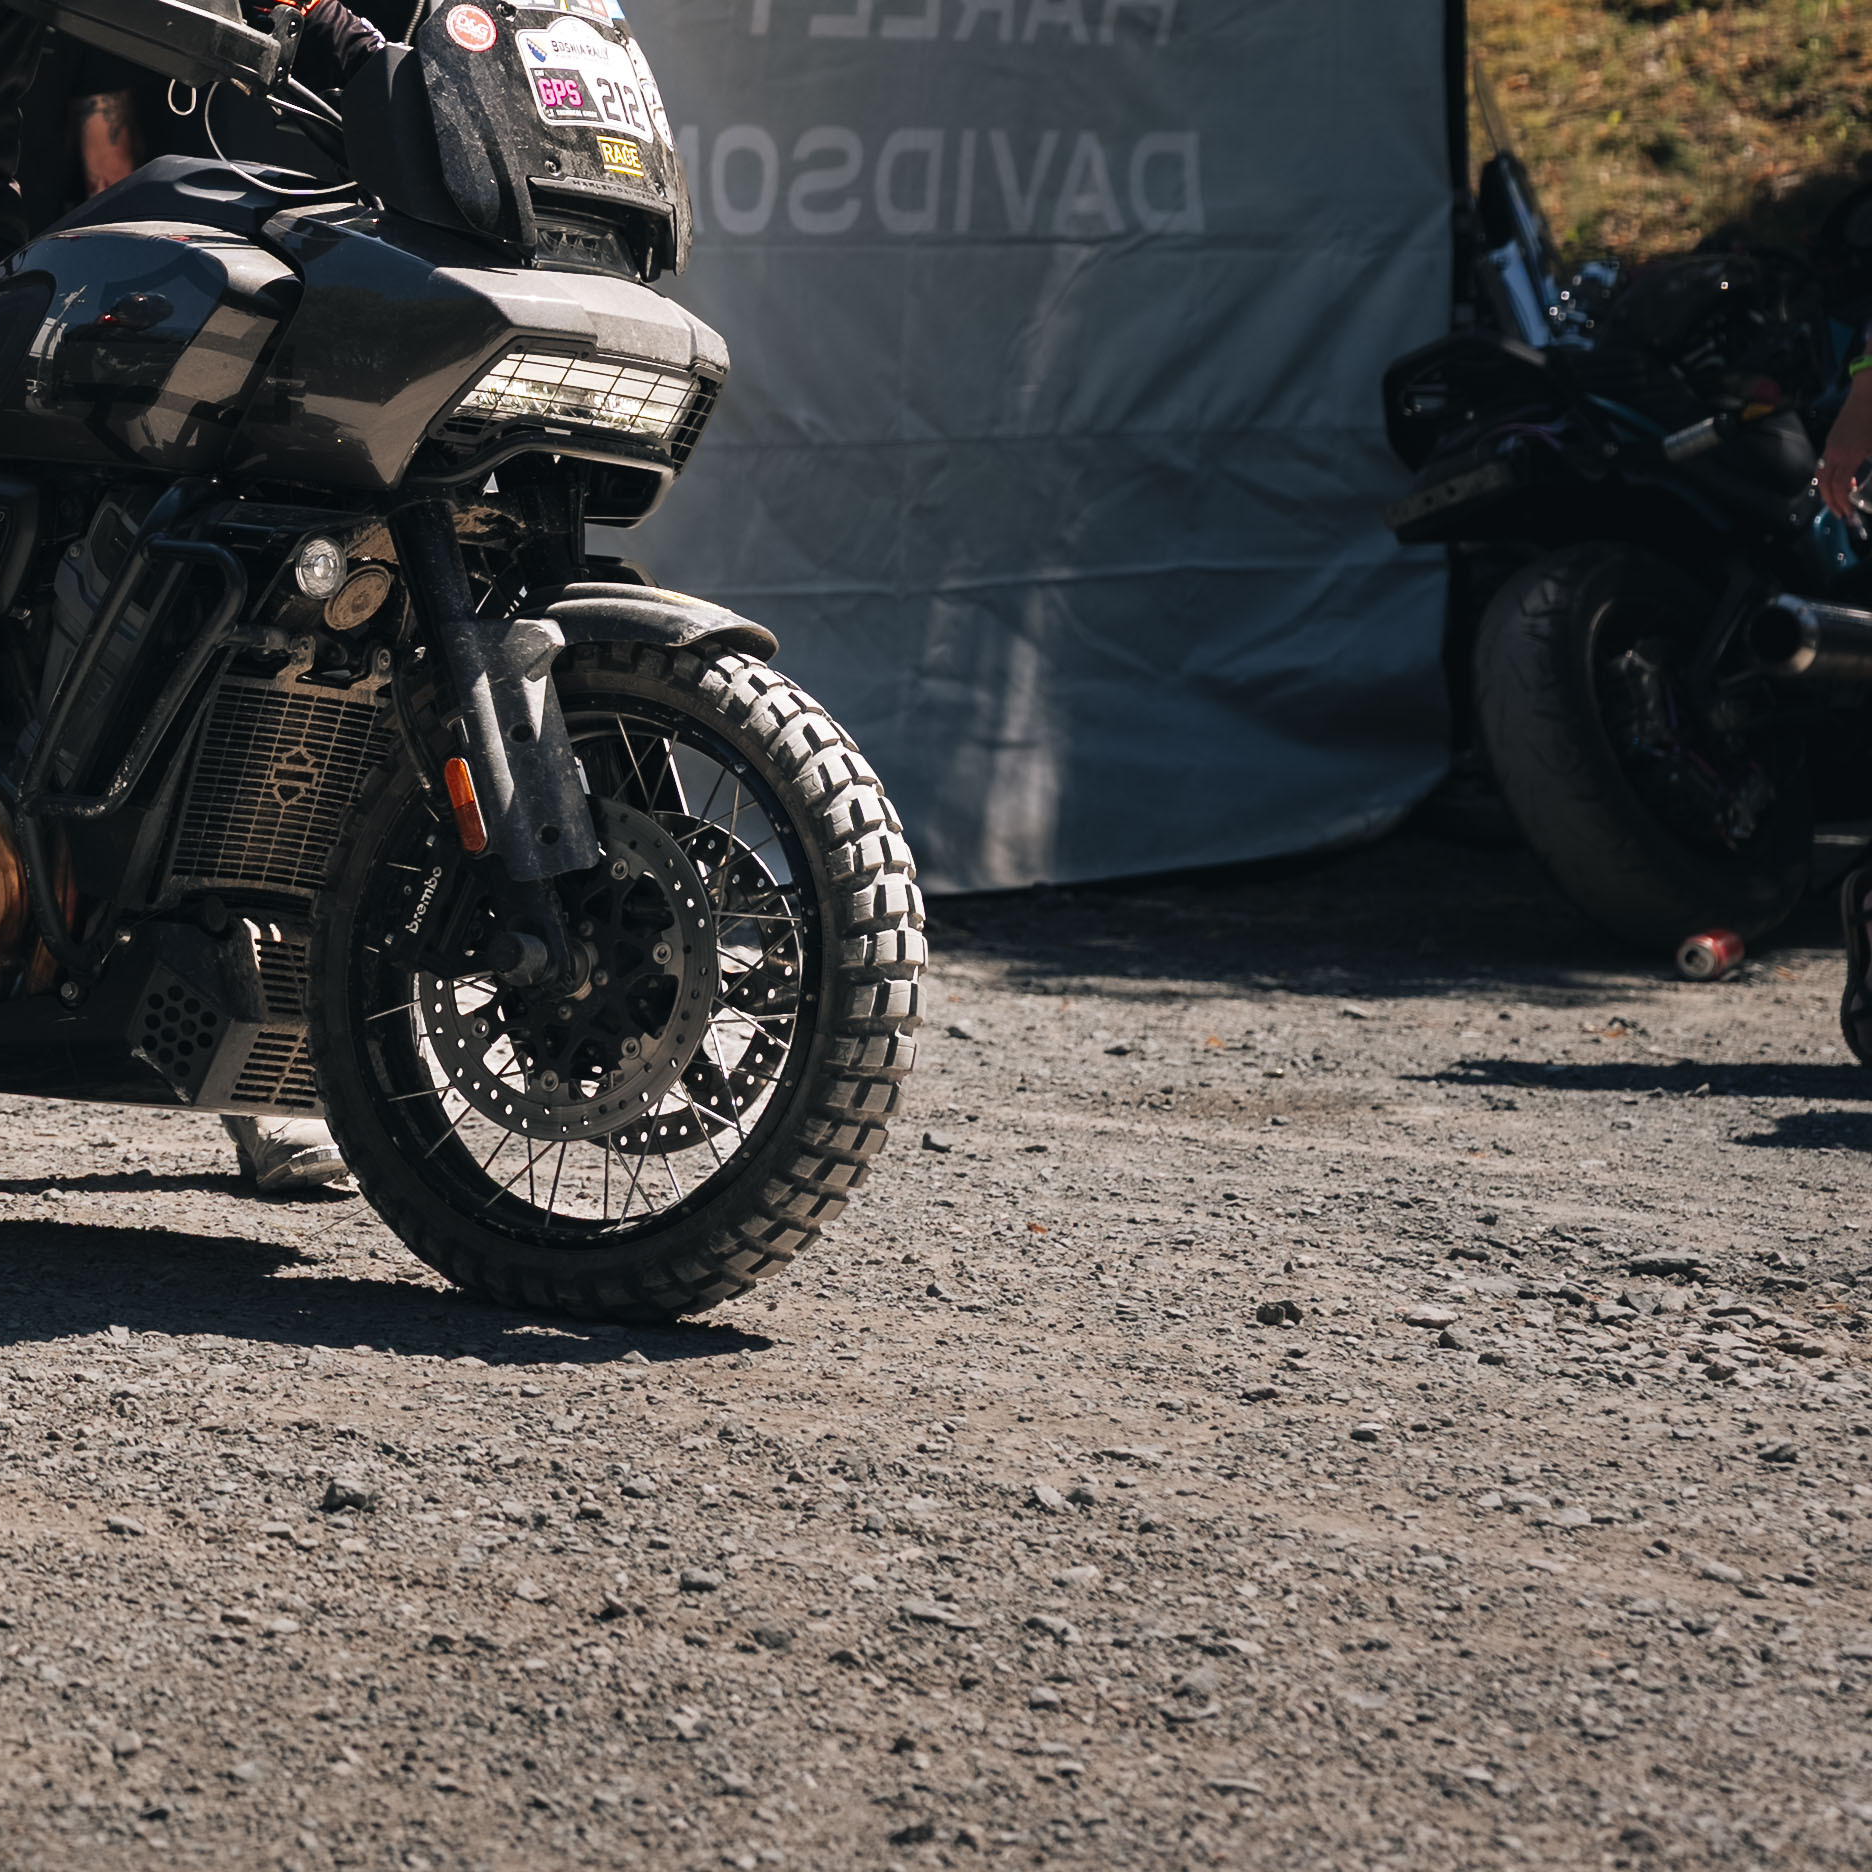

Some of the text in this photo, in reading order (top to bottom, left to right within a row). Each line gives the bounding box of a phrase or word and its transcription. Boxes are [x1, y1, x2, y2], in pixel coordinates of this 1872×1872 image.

[537, 77, 584, 108] GPS
[596, 77, 646, 132] 212
[601, 142, 642, 169] RACE
[405, 866, 442, 934] brembo
